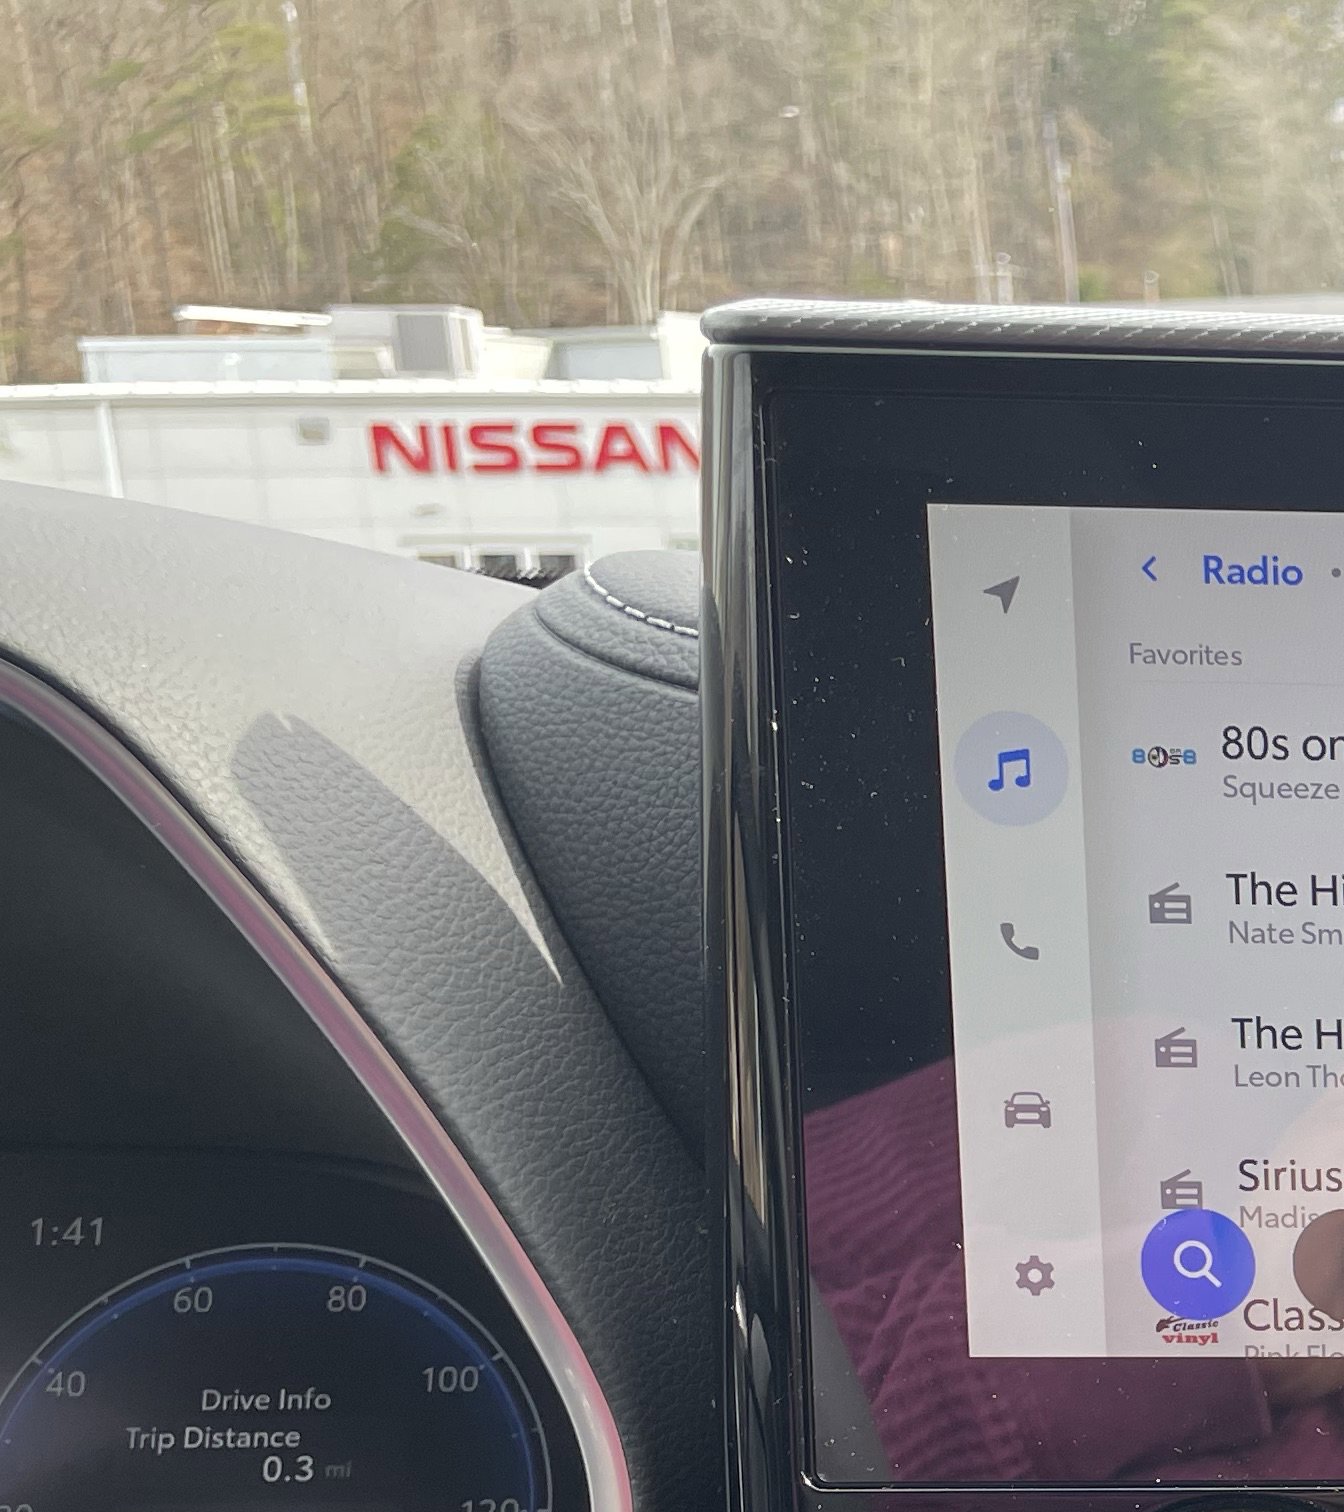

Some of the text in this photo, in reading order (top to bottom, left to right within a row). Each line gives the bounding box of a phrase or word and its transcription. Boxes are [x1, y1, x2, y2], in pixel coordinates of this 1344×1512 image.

[369, 422, 699, 473] NISSAN
[1203, 555, 1303, 587] Radio
[1129, 641, 1243, 668] Favorites
[1221, 725, 1289, 763] 80s
[1222, 775, 1341, 806] Squeeze
[1226, 873, 1299, 907] The
[1229, 922, 1296, 946] Nate
[1232, 1016, 1304, 1051] The
[1234, 1064, 1302, 1089] Leon
[30, 1216, 105, 1247] 1:41
[174, 1287, 212, 1314] 60
[327, 1286, 366, 1313] 80
[46, 1371, 86, 1398] 40
[422, 1366, 479, 1393] 100
[202, 1389, 331, 1412] Drive Info
[127, 1427, 301, 1451] Trip Distance
[262, 1456, 314, 1483] 0.3
